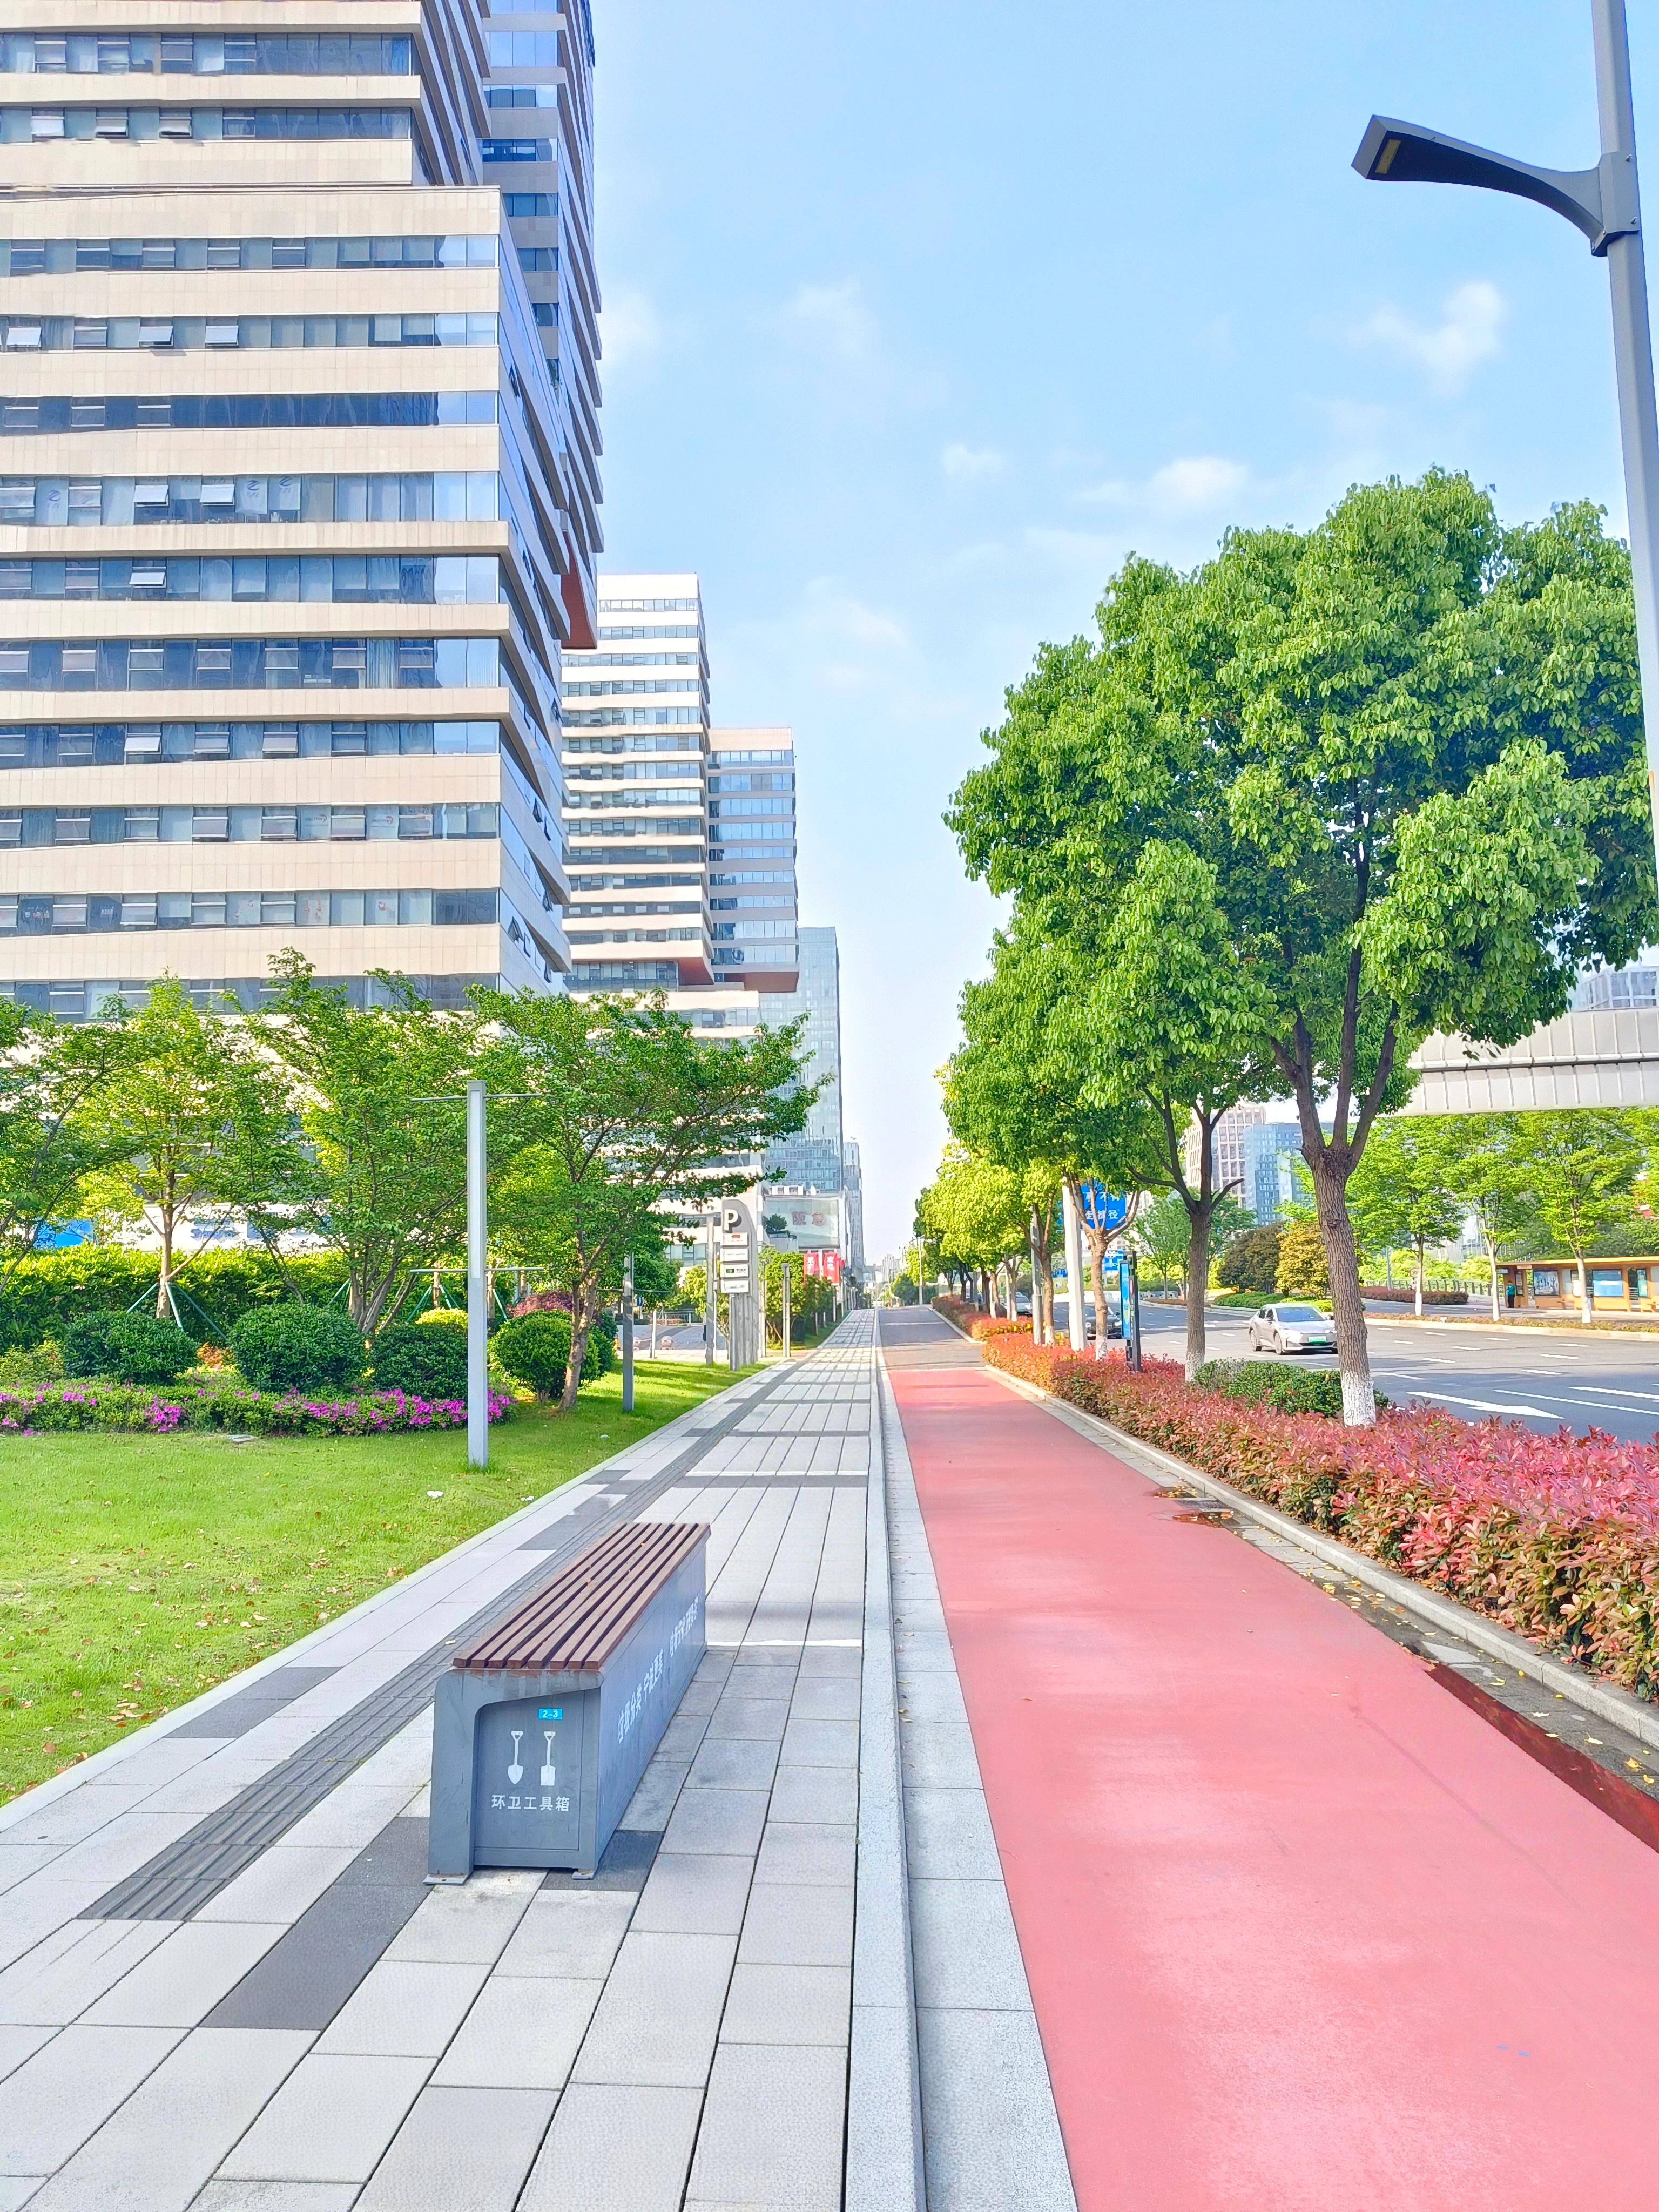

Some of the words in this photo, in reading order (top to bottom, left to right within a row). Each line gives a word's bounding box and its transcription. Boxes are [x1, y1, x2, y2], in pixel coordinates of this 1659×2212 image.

[724, 1209, 738, 1231] P
[792, 1211, 825, 1226] 阪急
[543, 1710, 558, 1718] 2-3
[617, 1683, 642, 1744] 垃圾分类
[491, 1795, 570, 1812] 环卫工具箱
